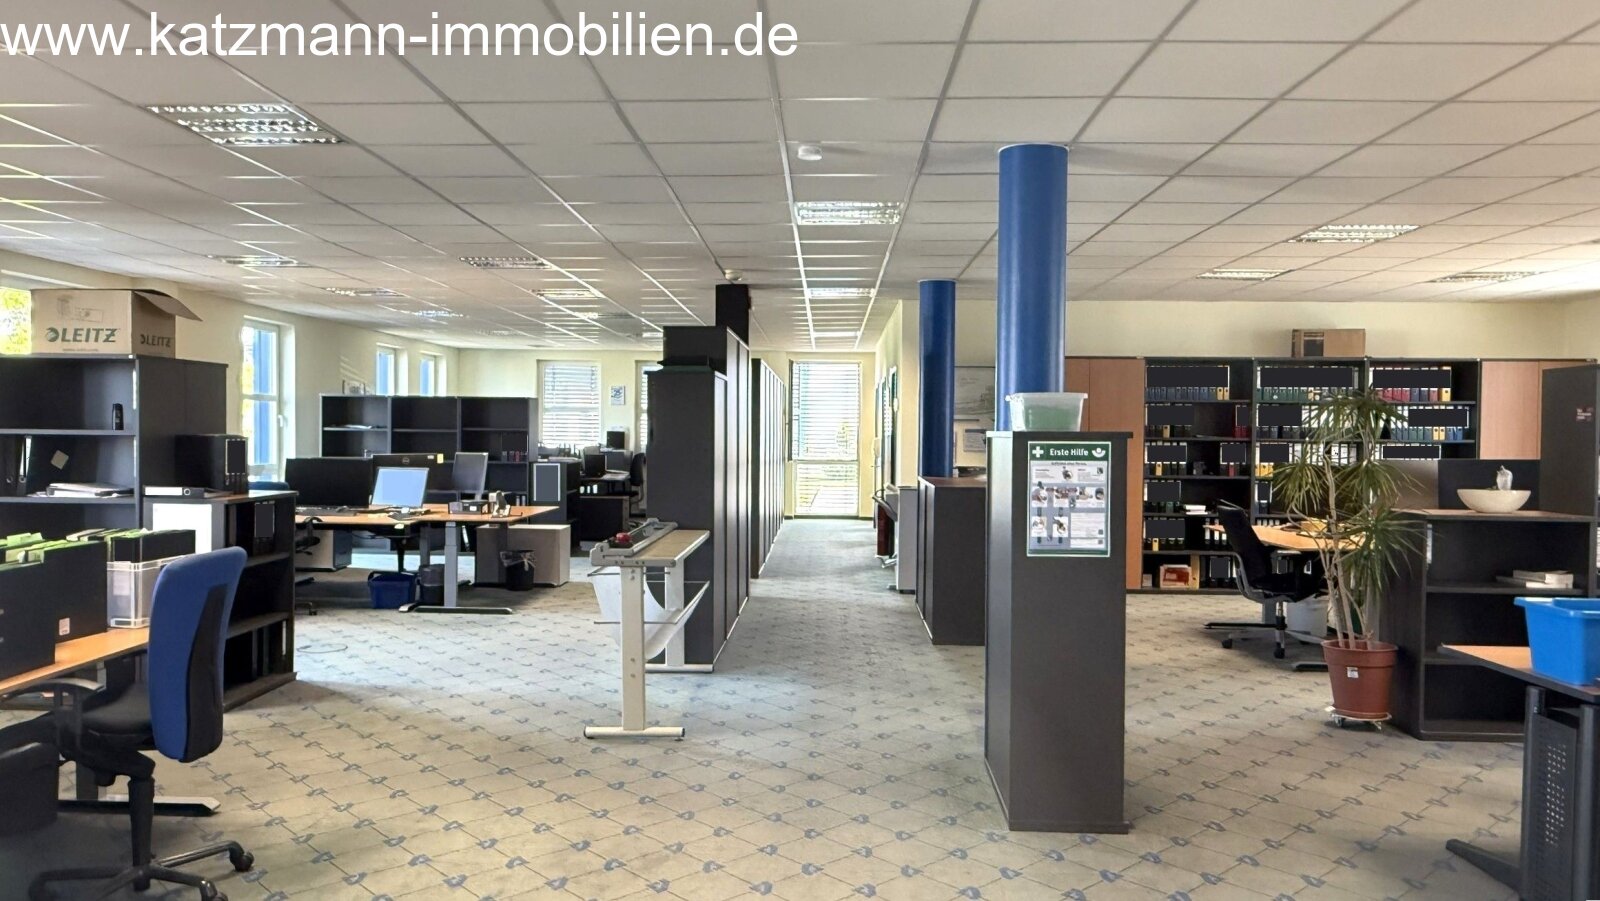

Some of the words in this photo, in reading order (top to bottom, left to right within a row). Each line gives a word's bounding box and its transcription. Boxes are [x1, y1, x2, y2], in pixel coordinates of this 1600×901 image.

[60, 328, 118, 343] LEITZ
[146, 335, 171, 348] LEITZ
[1049, 448, 1069, 456] Erste
[1070, 448, 1089, 456] Hilfe
